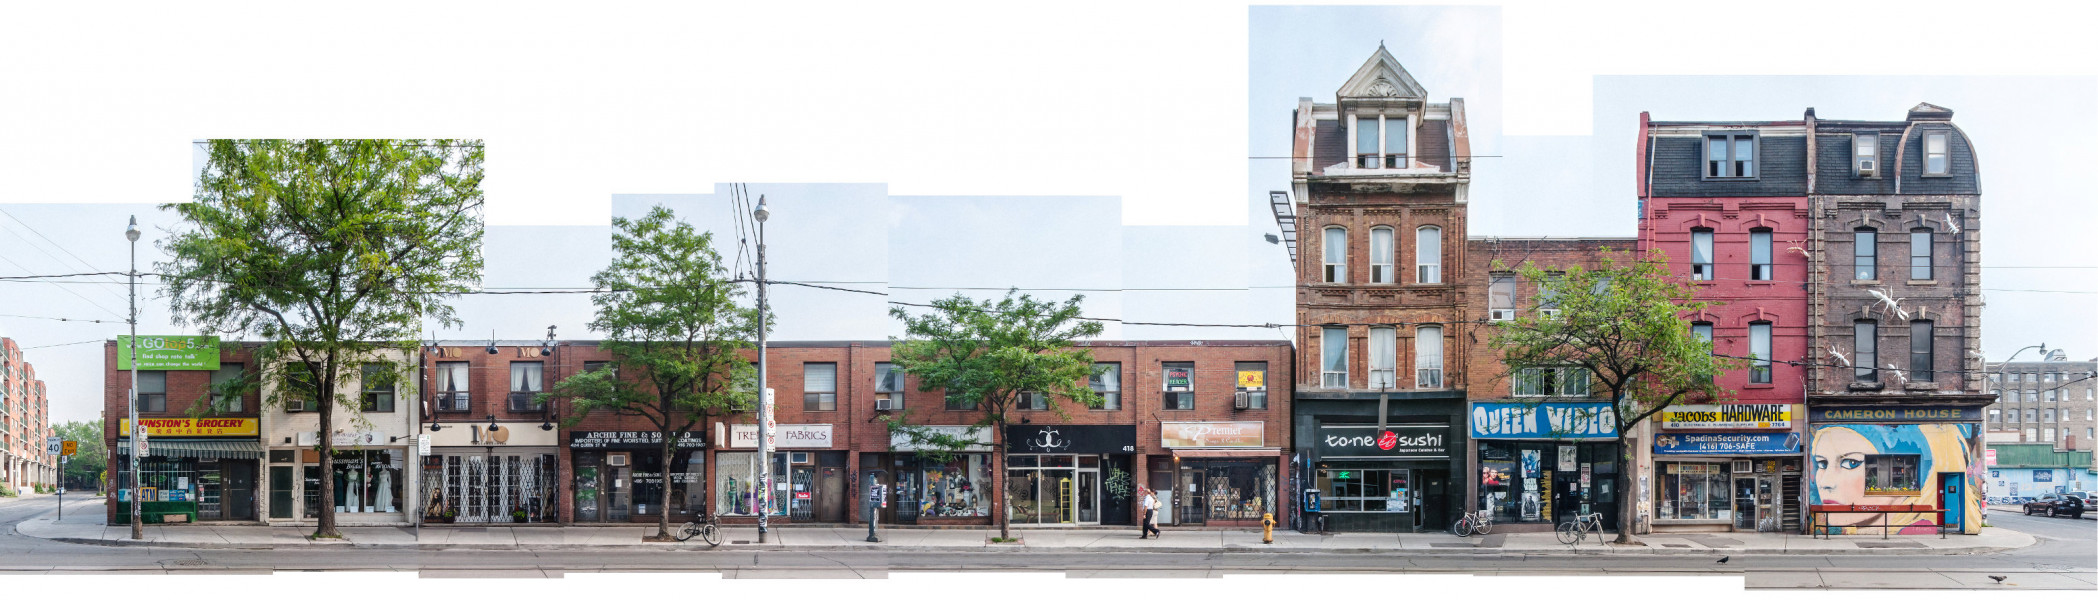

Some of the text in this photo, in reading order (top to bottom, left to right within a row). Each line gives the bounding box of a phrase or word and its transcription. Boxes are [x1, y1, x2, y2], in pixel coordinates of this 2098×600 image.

[1721, 404, 1784, 421] HARDWARE
[1824, 409, 1962, 419] CAMERON HOUSE
[196, 419, 244, 428] GROCERY
[1473, 405, 1616, 435] QUEEN VIDEO
[586, 431, 617, 439] ARCHIE
[620, 431, 637, 439] FINE
[785, 431, 827, 440] FABRICS
[1685, 434, 1769, 443] SpadinaSecurity.com
[1399, 433, 1442, 447] sushi
[48, 443, 60, 452] 40
[1699, 442, 1756, 450] (416) 706-SAFE
[141, 488, 156, 501] ATM
